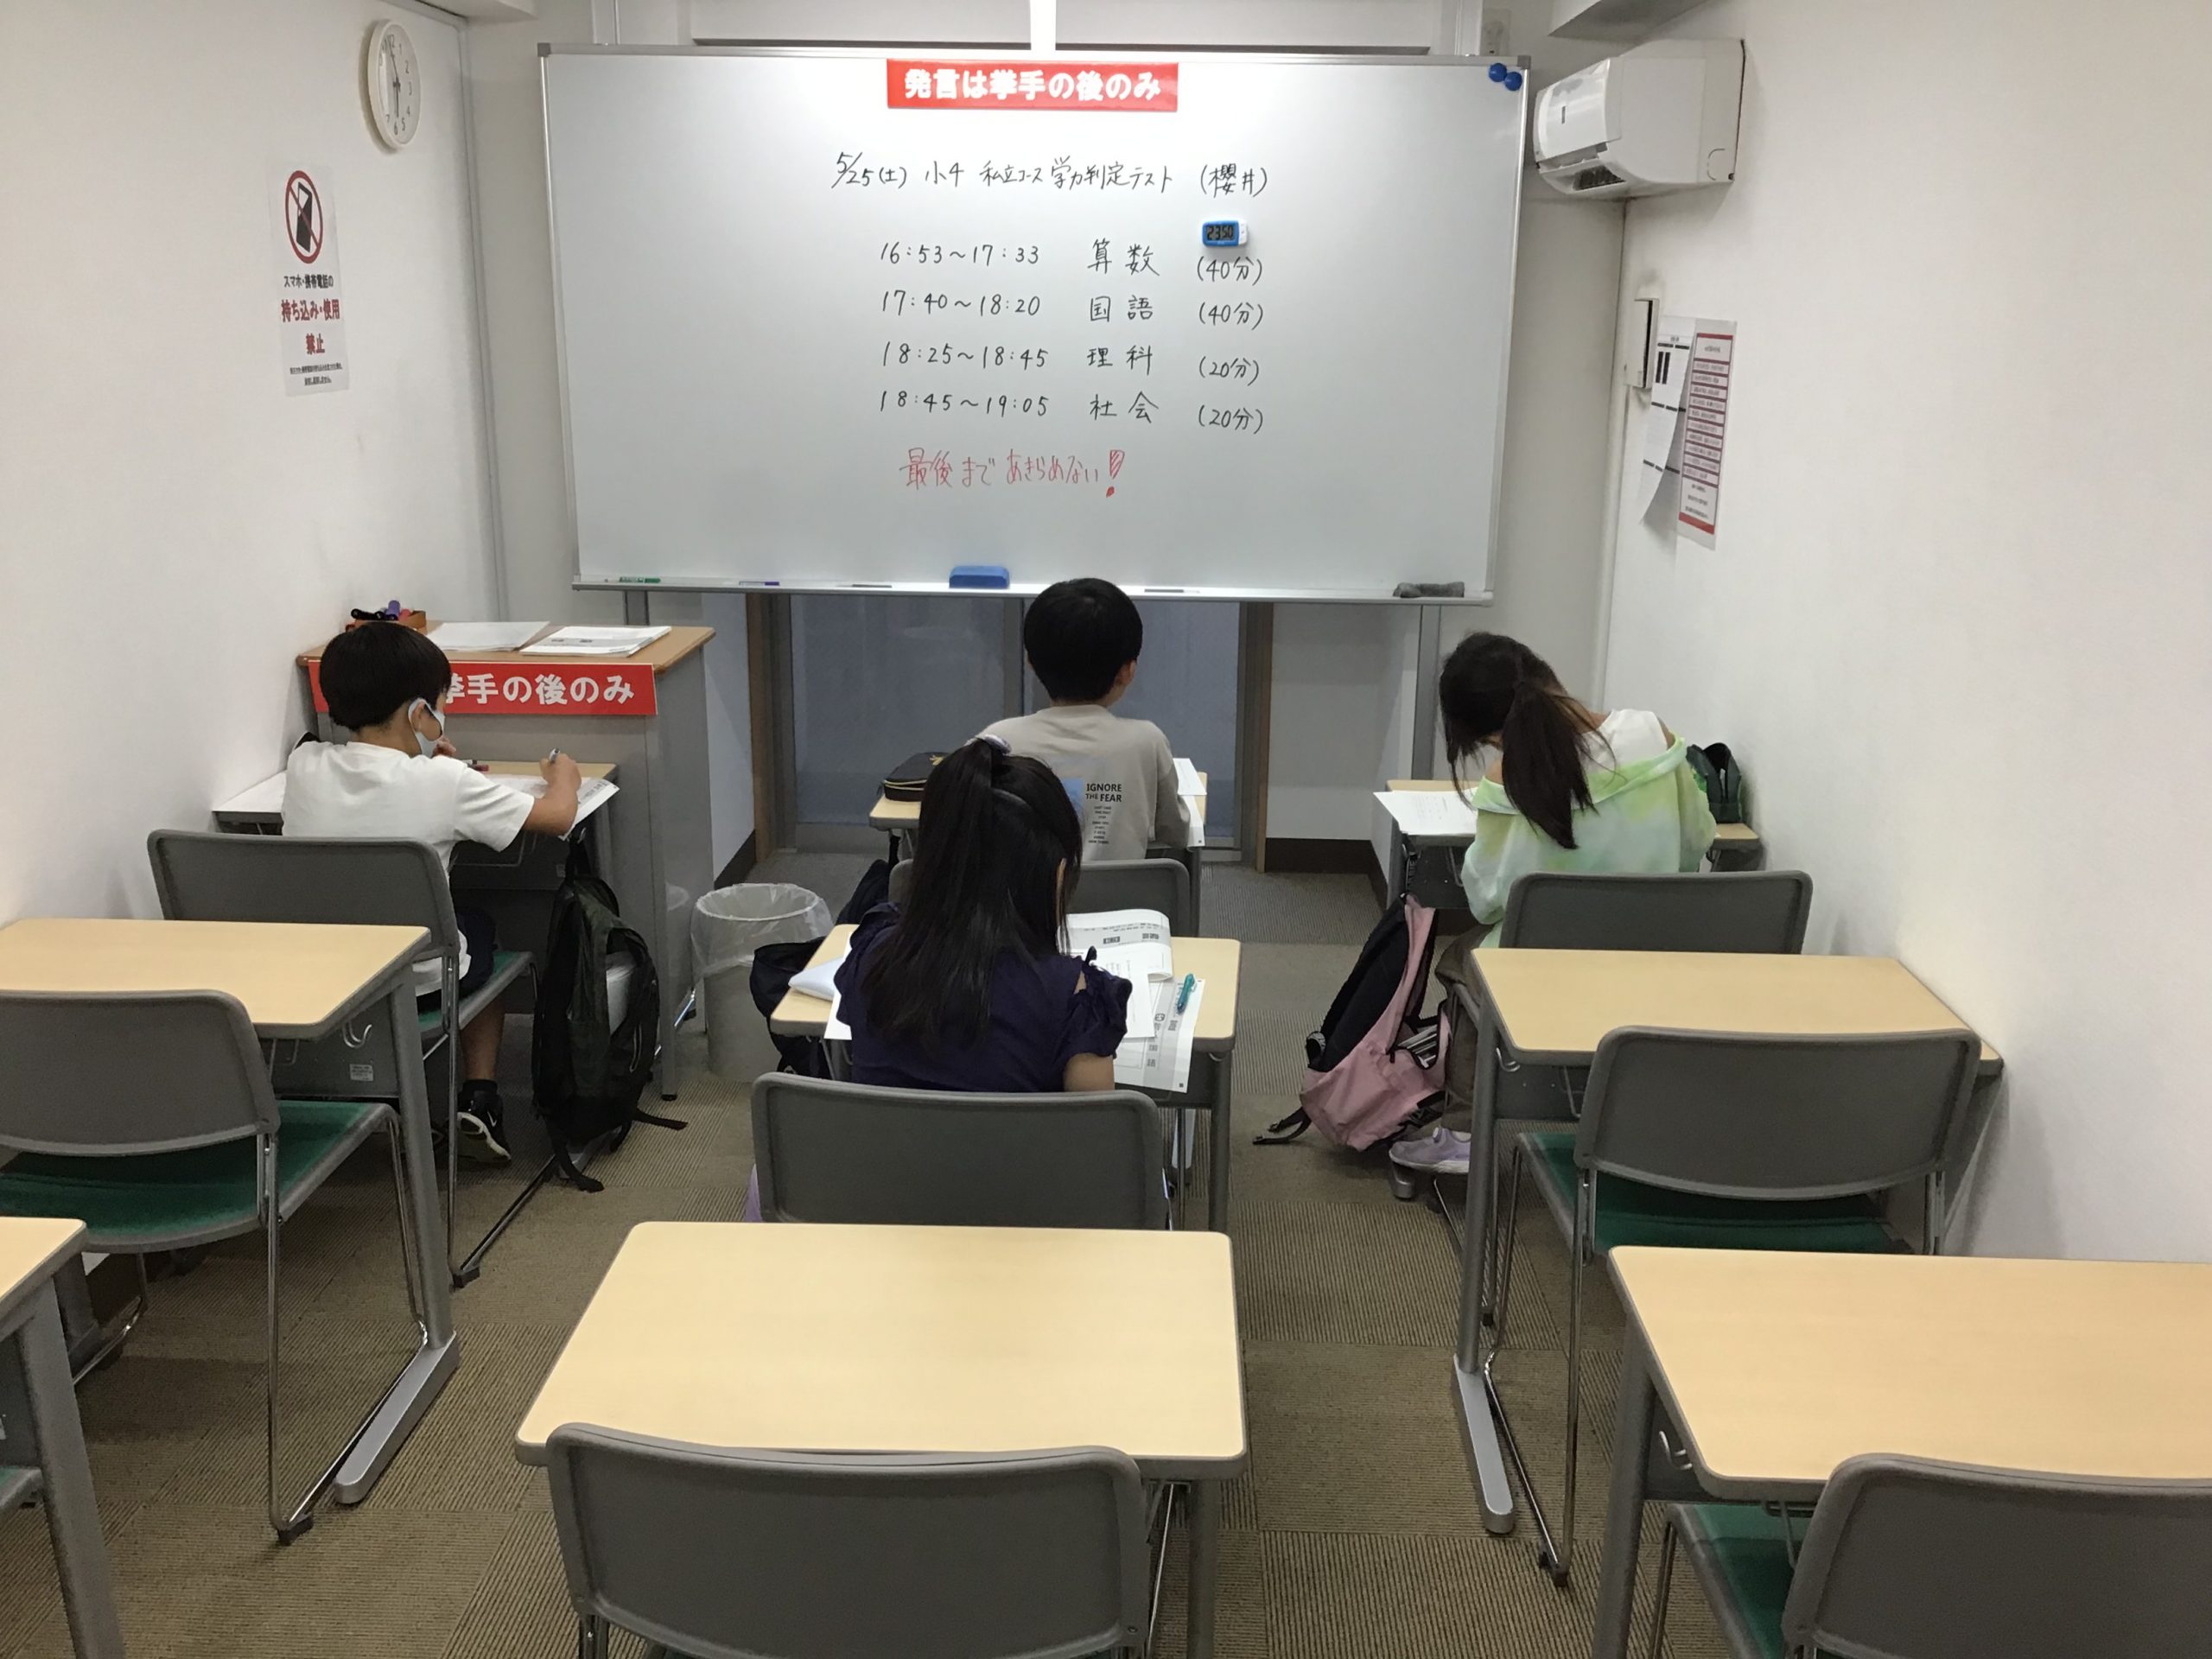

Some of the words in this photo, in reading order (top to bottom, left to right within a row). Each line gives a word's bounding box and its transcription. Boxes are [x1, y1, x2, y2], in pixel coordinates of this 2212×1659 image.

[905, 69, 1161, 101] 発言は挙手の後のみ
[305, 333, 326, 355] 禁止
[1086, 783, 1122, 792] IGNORE
[1100, 793, 1122, 803] FEAR
